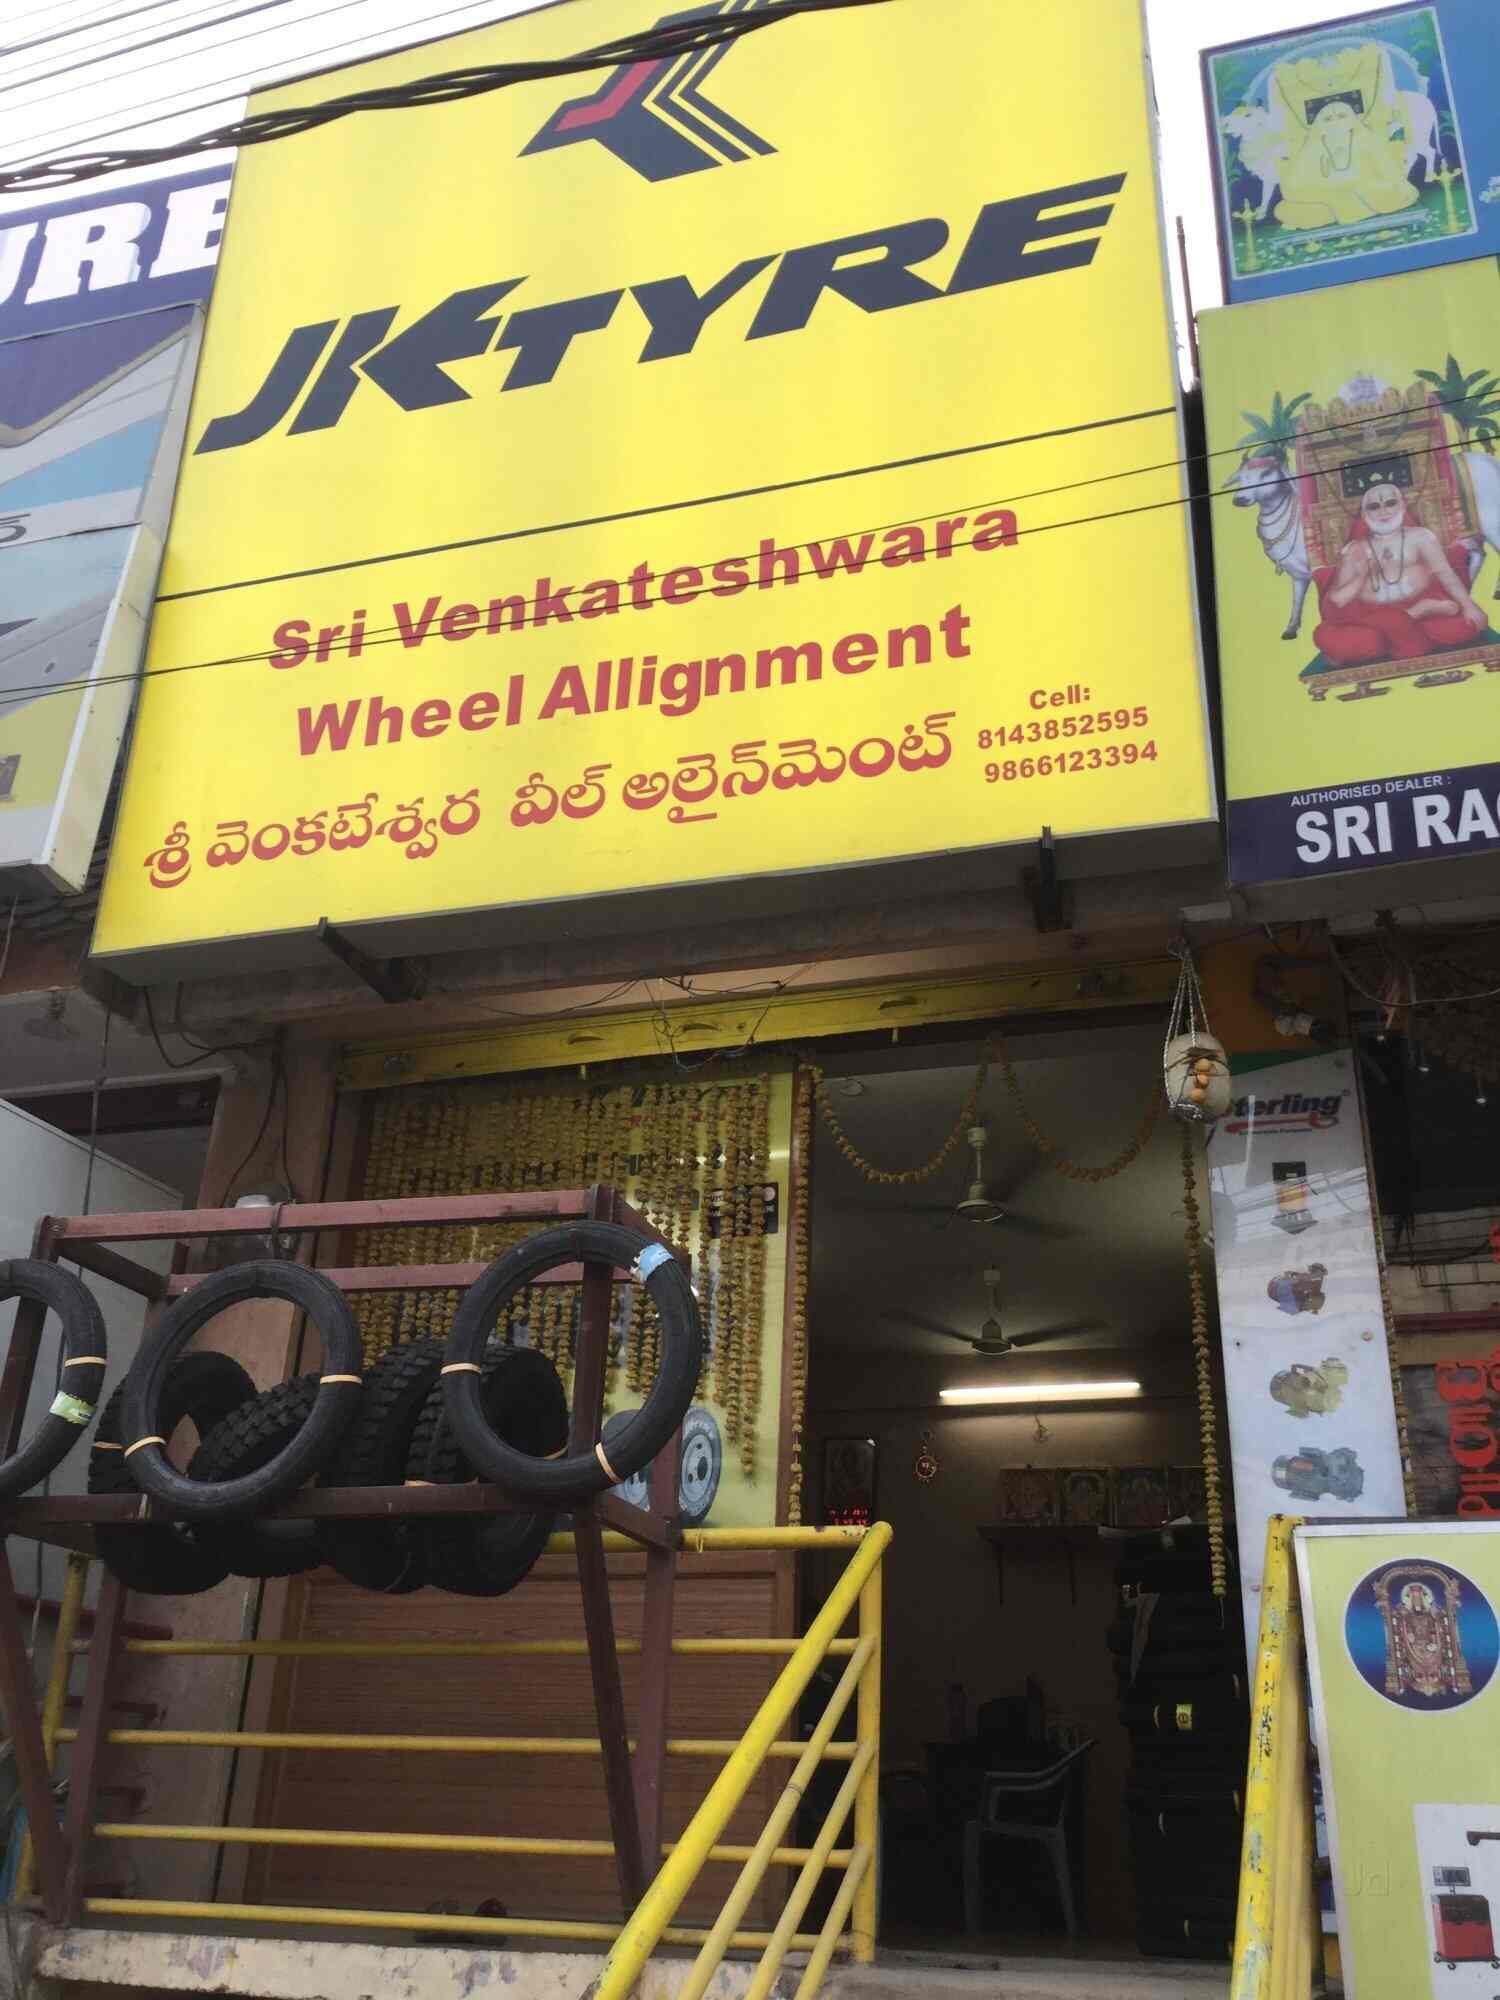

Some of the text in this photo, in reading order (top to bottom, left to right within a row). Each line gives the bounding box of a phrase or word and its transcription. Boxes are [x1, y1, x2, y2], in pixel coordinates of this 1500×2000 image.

[269, 508, 1019, 670] Sri Venkateshwara
[297, 606, 973, 758] Wheel Allignment
[1028, 683, 1091, 711] Cell:
[977, 705, 1149, 750] 8143852595
[983, 739, 1159, 784] 9866123394
[1290, 783, 1382, 808] AUTHORISED
[1384, 774, 1444, 794] DEALER
[143, 820, 192, 890] శ్రీ
[205, 787, 481, 869] వెంకటేశ్వర
[509, 762, 613, 829] వీల్
[1295, 788, 1500, 864] SRI RA
[1230, 1092, 1342, 1119] terling
